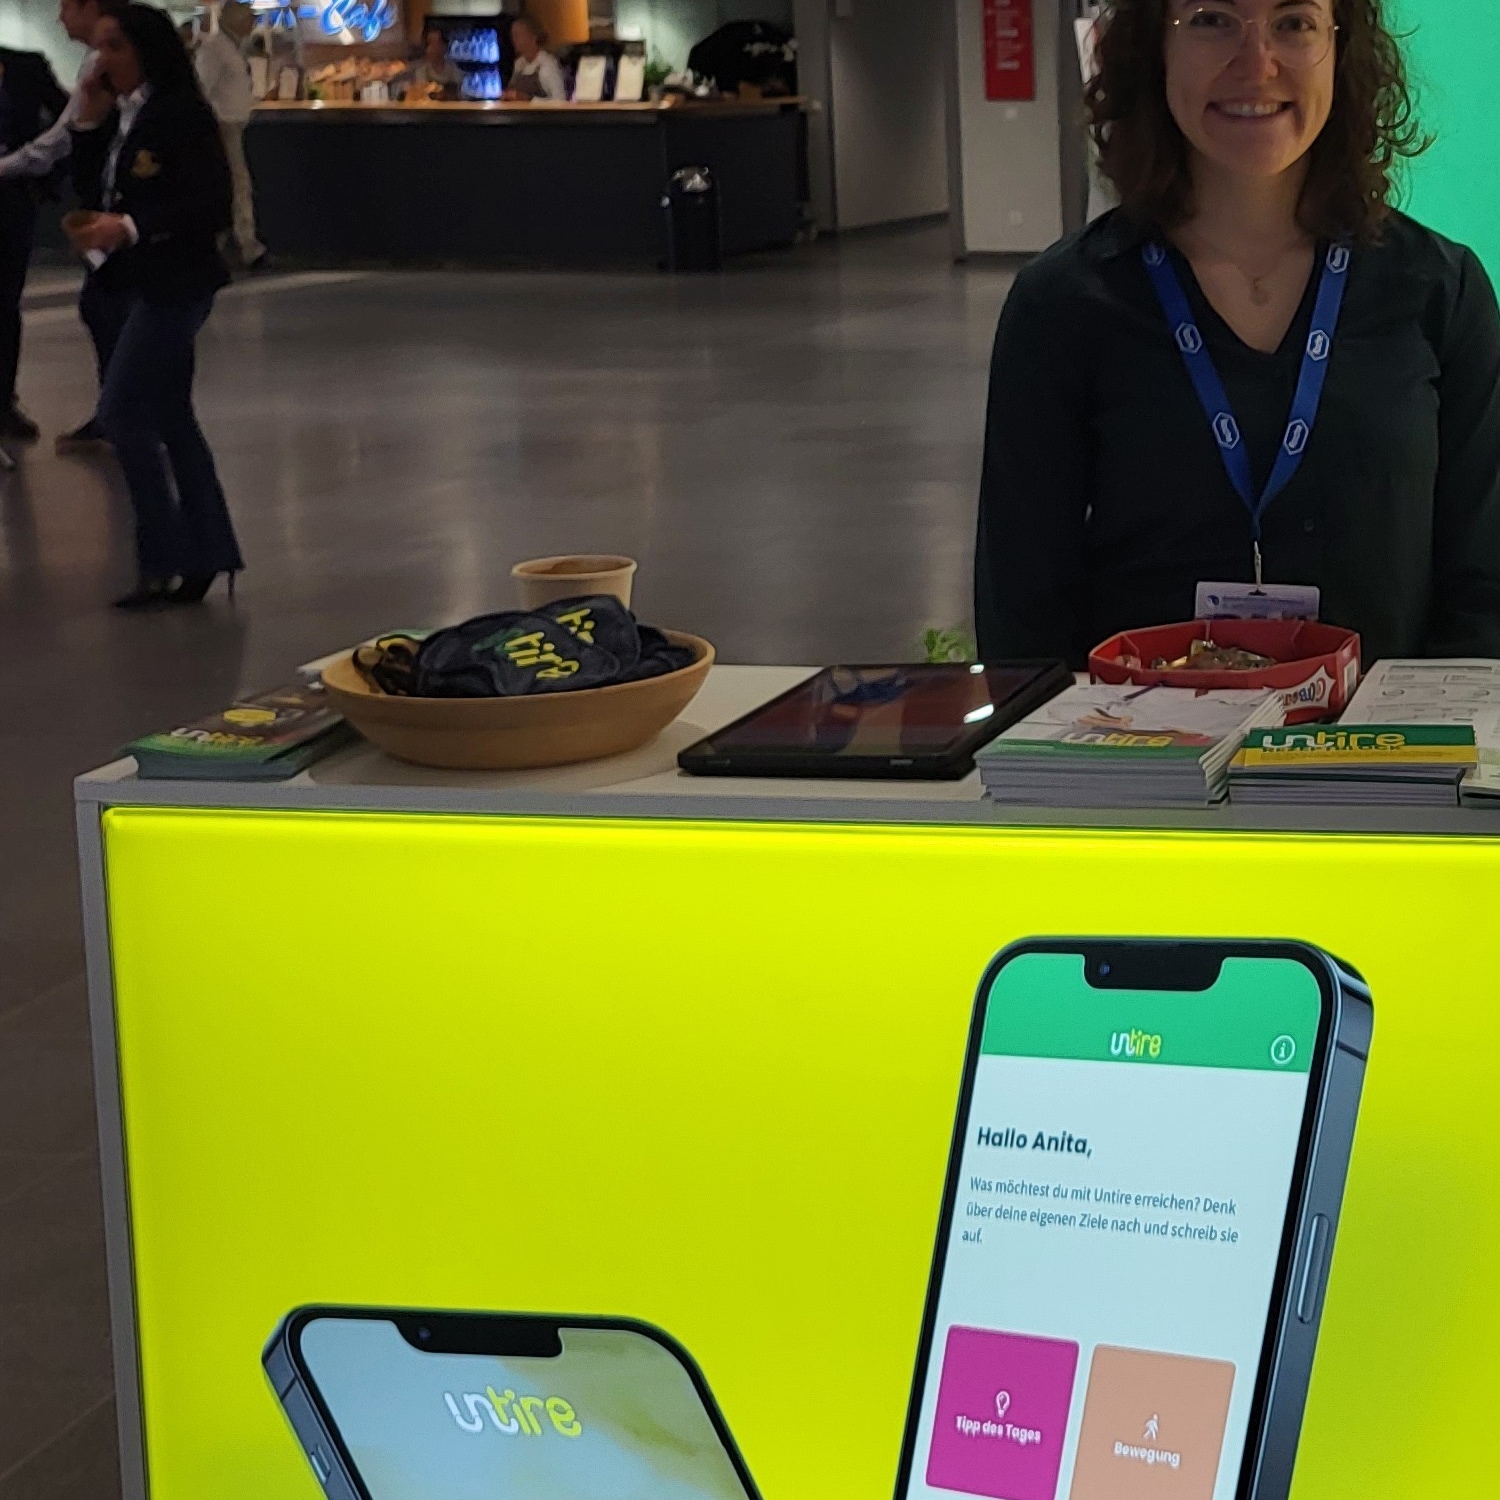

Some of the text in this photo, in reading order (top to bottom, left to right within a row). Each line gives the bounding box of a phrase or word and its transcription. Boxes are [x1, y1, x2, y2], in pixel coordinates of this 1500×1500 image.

[1262, 731, 1405, 751] untire
[1110, 1027, 1163, 1059] untire
[976, 1126, 1093, 1158] Hallo Anita,
[970, 1175, 1237, 1216] Was möchtest du mit Untire erreichen? Denk
[961, 1227, 983, 1245] auf.
[966, 1201, 1239, 1244] über deine eigenen Ziele nach und schreib sie
[444, 1385, 583, 1437] untire
[956, 1415, 1041, 1446] Tipp des Tages
[1114, 1441, 1181, 1469] Bewegung
